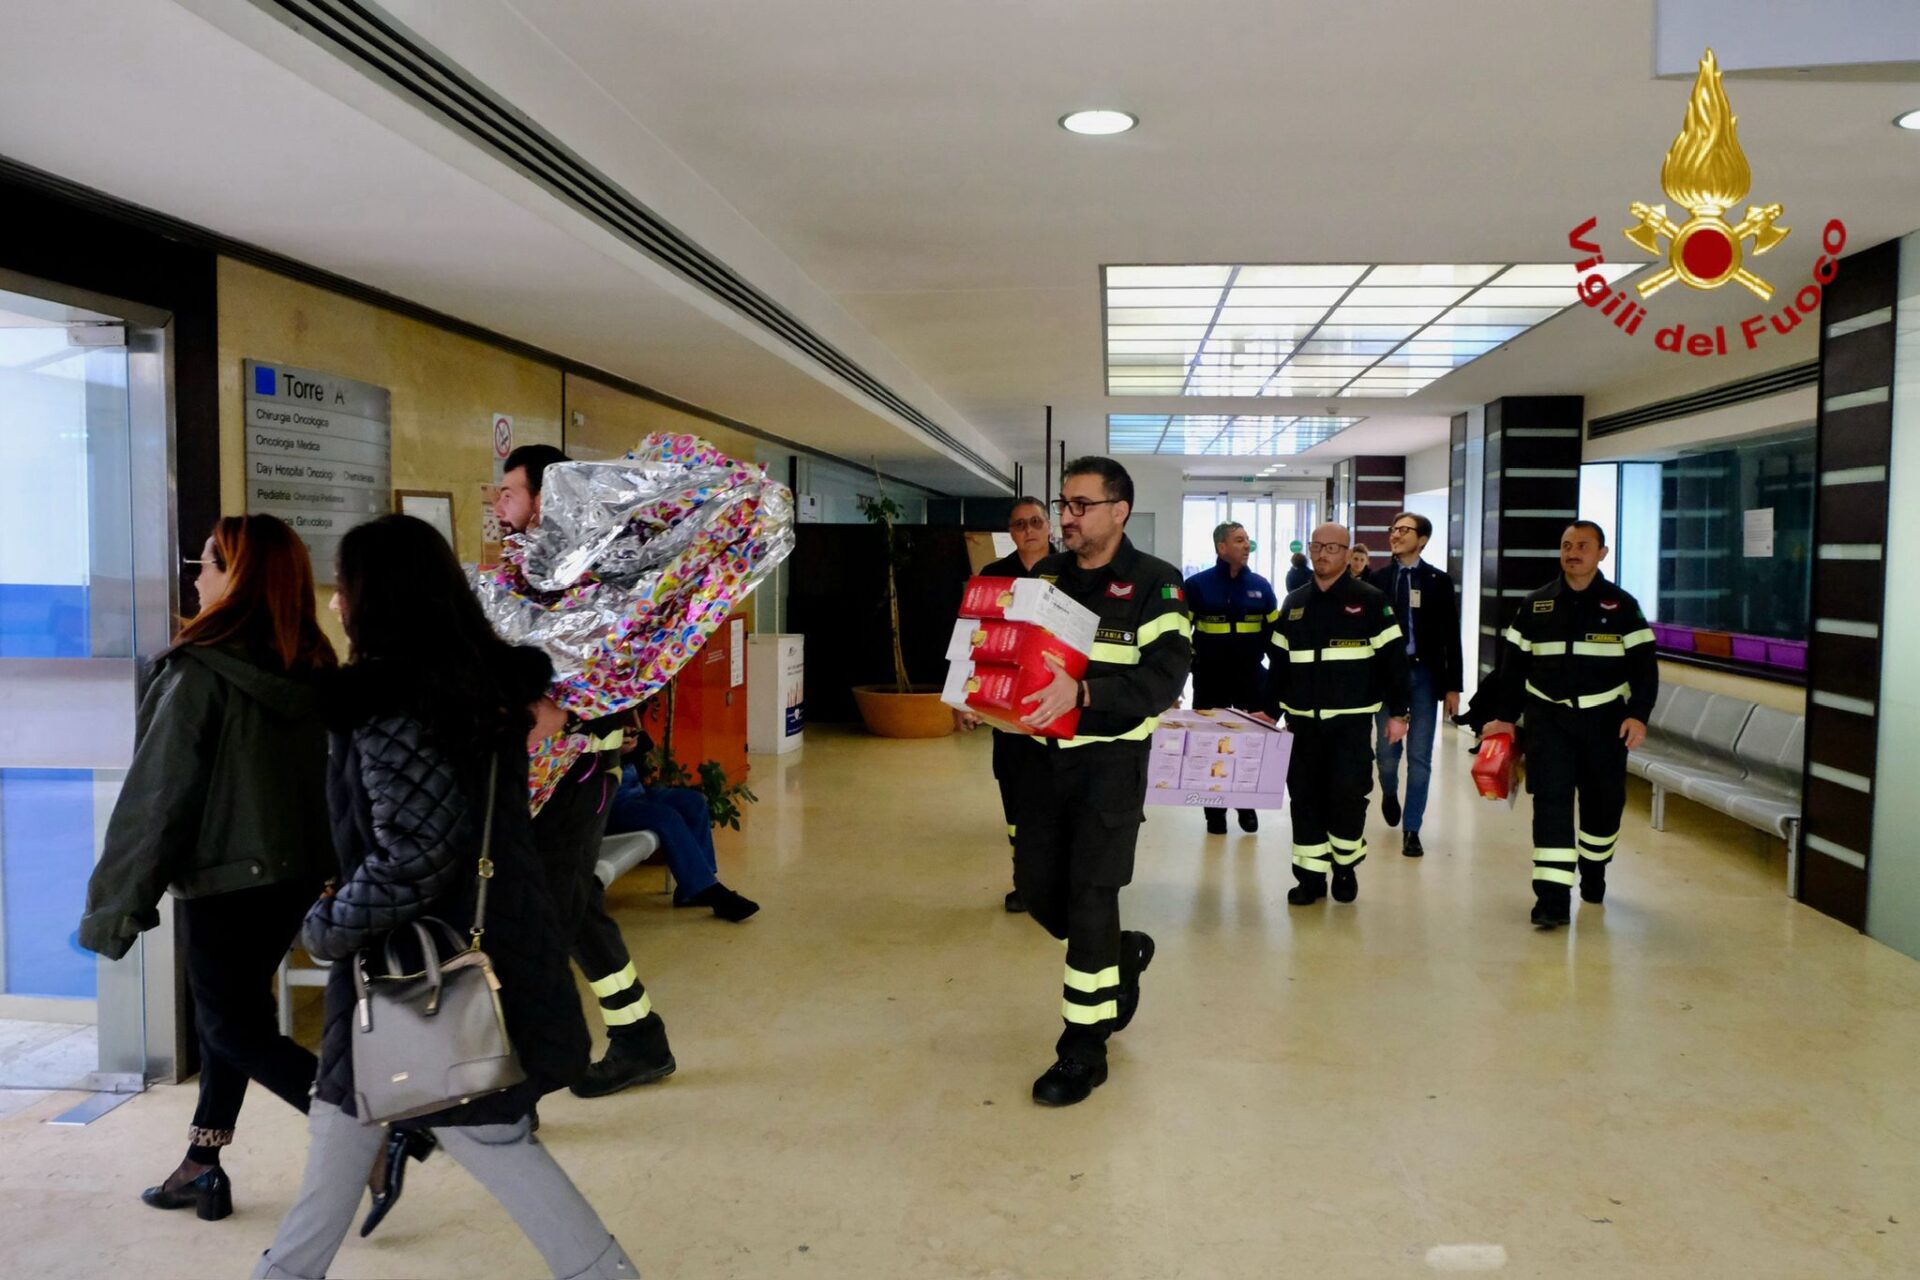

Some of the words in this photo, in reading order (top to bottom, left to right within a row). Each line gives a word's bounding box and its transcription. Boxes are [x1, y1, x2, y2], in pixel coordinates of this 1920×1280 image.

[283, 374, 324, 402] Torre
[335, 390, 345, 405] A
[256, 408, 291, 425] Chirurgia
[293, 412, 330, 429] Oncologica
[256, 434, 295, 450] Oncologia
[297, 439, 321, 452] Medica
[256, 462, 273, 477] Day
[275, 464, 304, 478] Hospital
[1096, 629, 1122, 640] ATANIA
